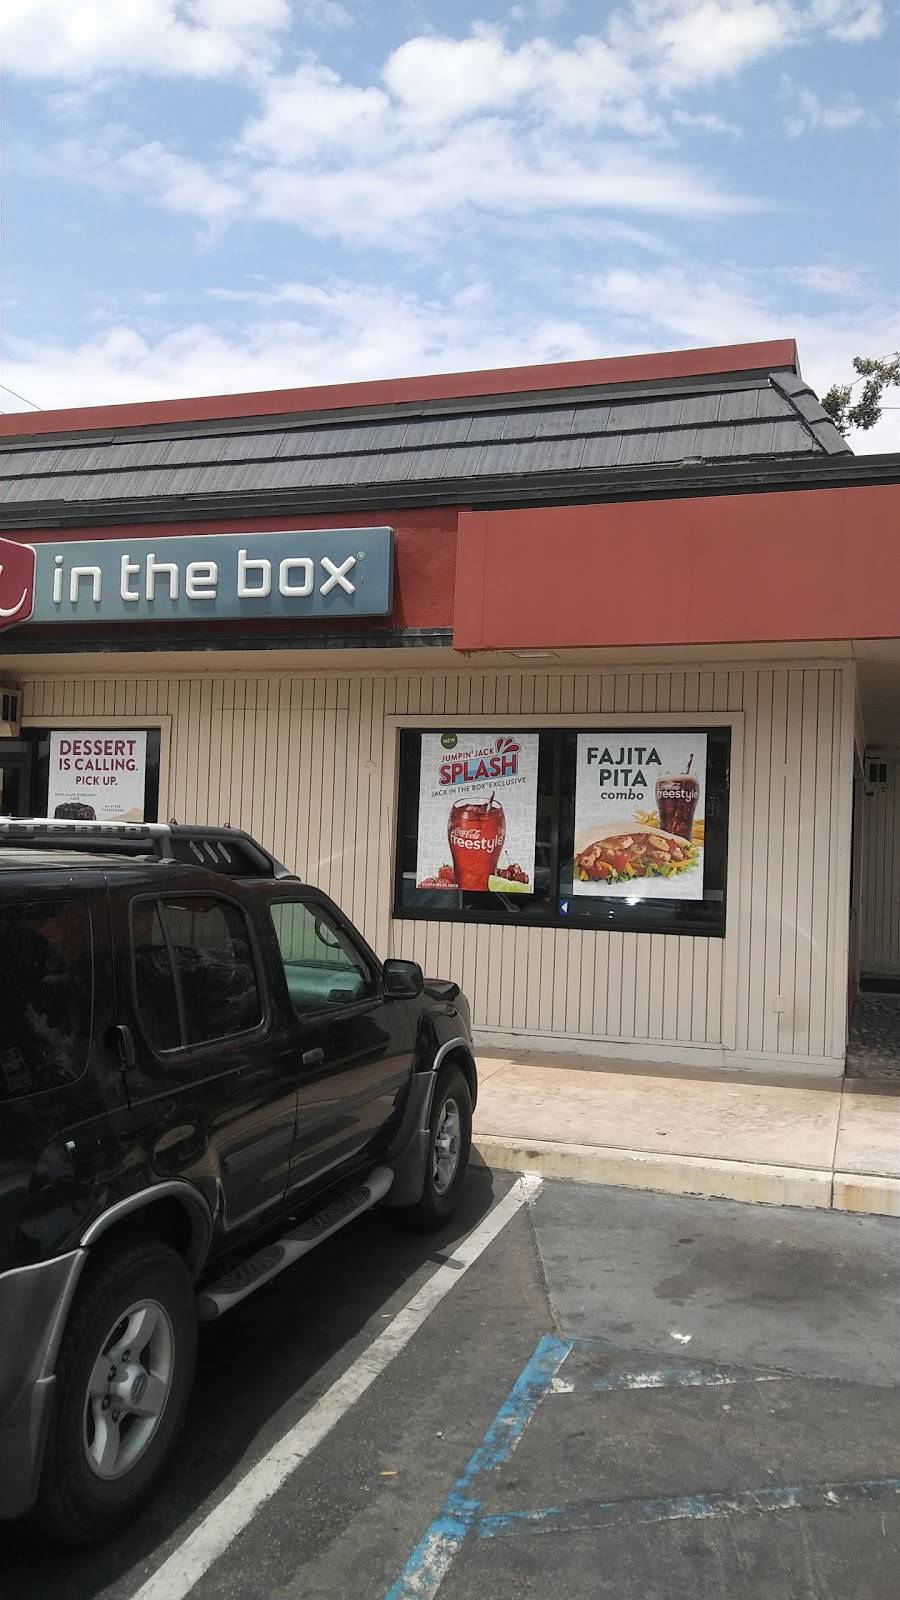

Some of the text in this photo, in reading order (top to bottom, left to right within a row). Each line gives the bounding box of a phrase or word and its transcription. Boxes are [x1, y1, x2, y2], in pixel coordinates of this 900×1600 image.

[52, 555, 102, 604] in
[120, 553, 219, 602] the
[59, 739, 137, 756] DESSERT
[441, 747, 495, 763] JUMPIN' JACK
[58, 758, 139, 772] IS CALLING.
[587, 747, 662, 766] FAJITA
[439, 754, 517, 785] SPLASH
[599, 769, 647, 787] PITA
[75, 775, 118, 786] PICK UP.
[431, 788, 448, 797] JACK
[449, 787, 456, 795] IN
[457, 785, 471, 793] THE
[488, 777, 527, 789] EXCLUSIVE
[600, 788, 644, 801] combo
[657, 788, 699, 803] freestyle
[450, 832, 504, 854] freestyle
